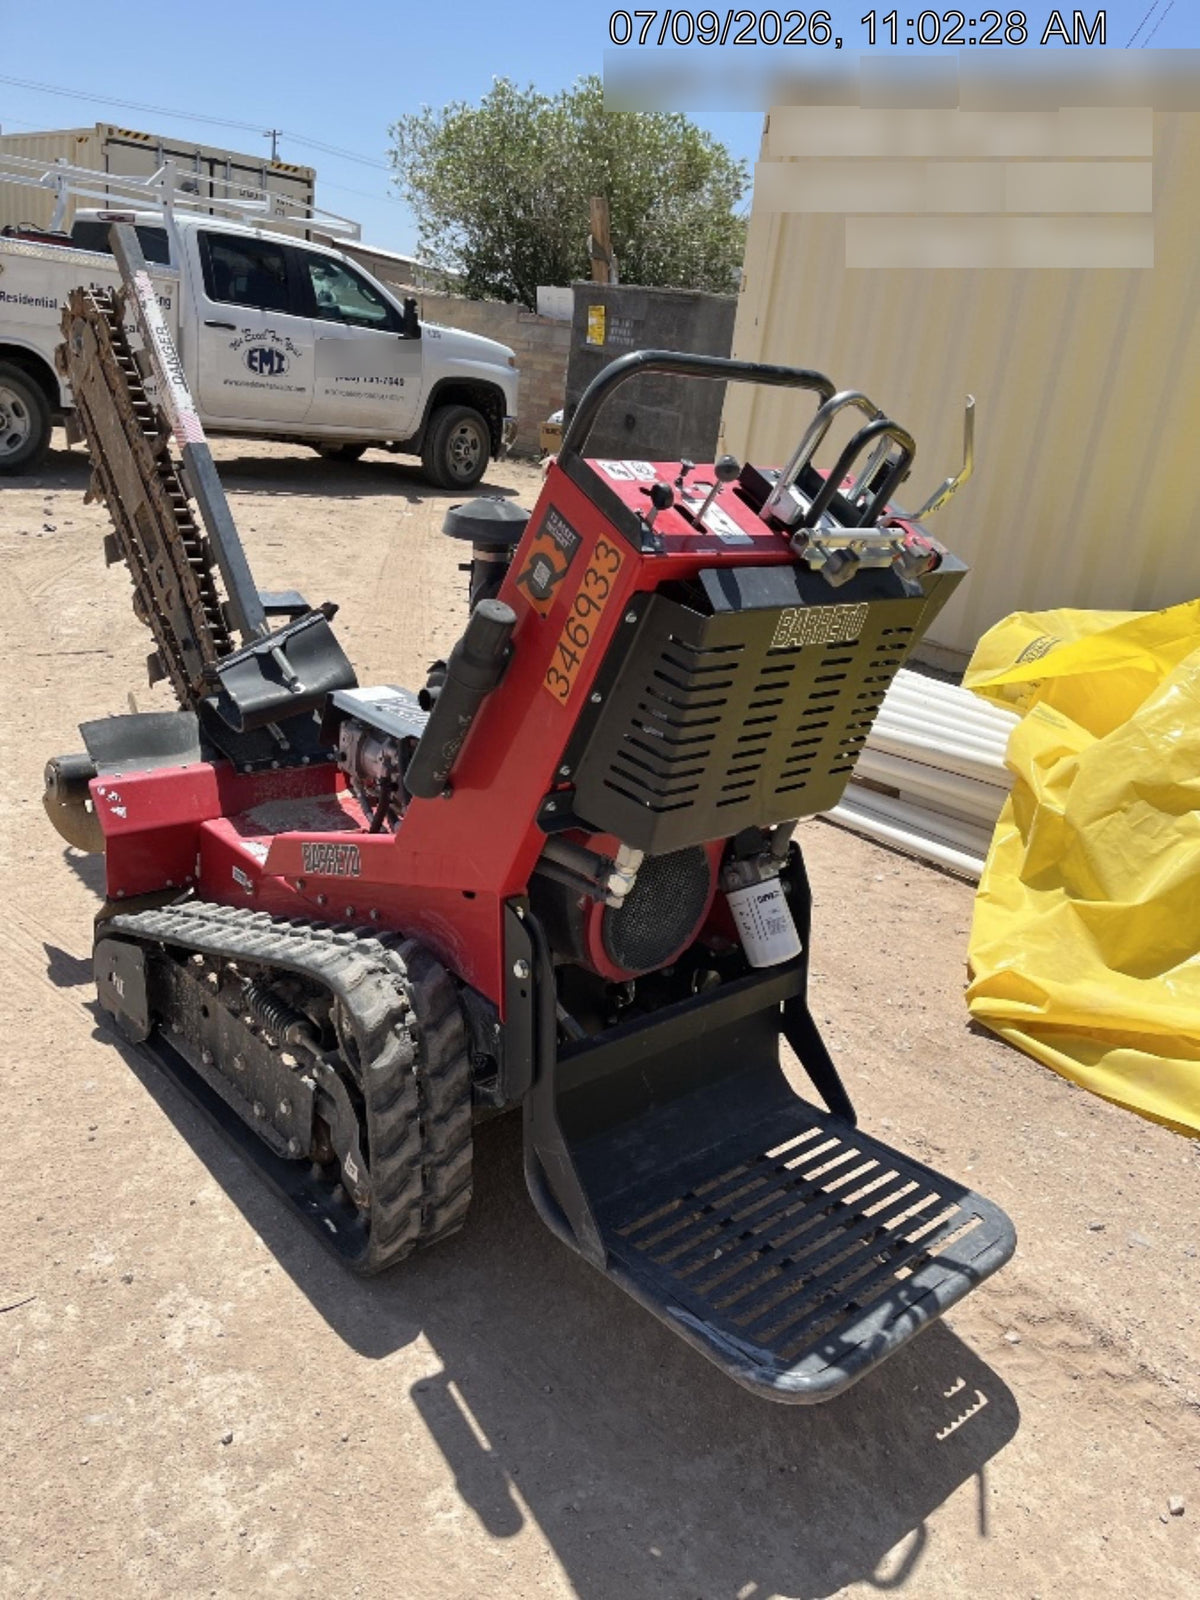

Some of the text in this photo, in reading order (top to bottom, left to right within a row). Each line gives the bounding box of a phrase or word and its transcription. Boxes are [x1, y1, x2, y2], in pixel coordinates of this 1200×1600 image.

[0, 291, 57, 309] Residential
[156, 325, 188, 387] DANGER
[247, 347, 285, 375] EMI
[546, 540, 621, 698] 346933
[770, 602, 870, 647] BARRETO
[302, 842, 361, 877] BARRETO
